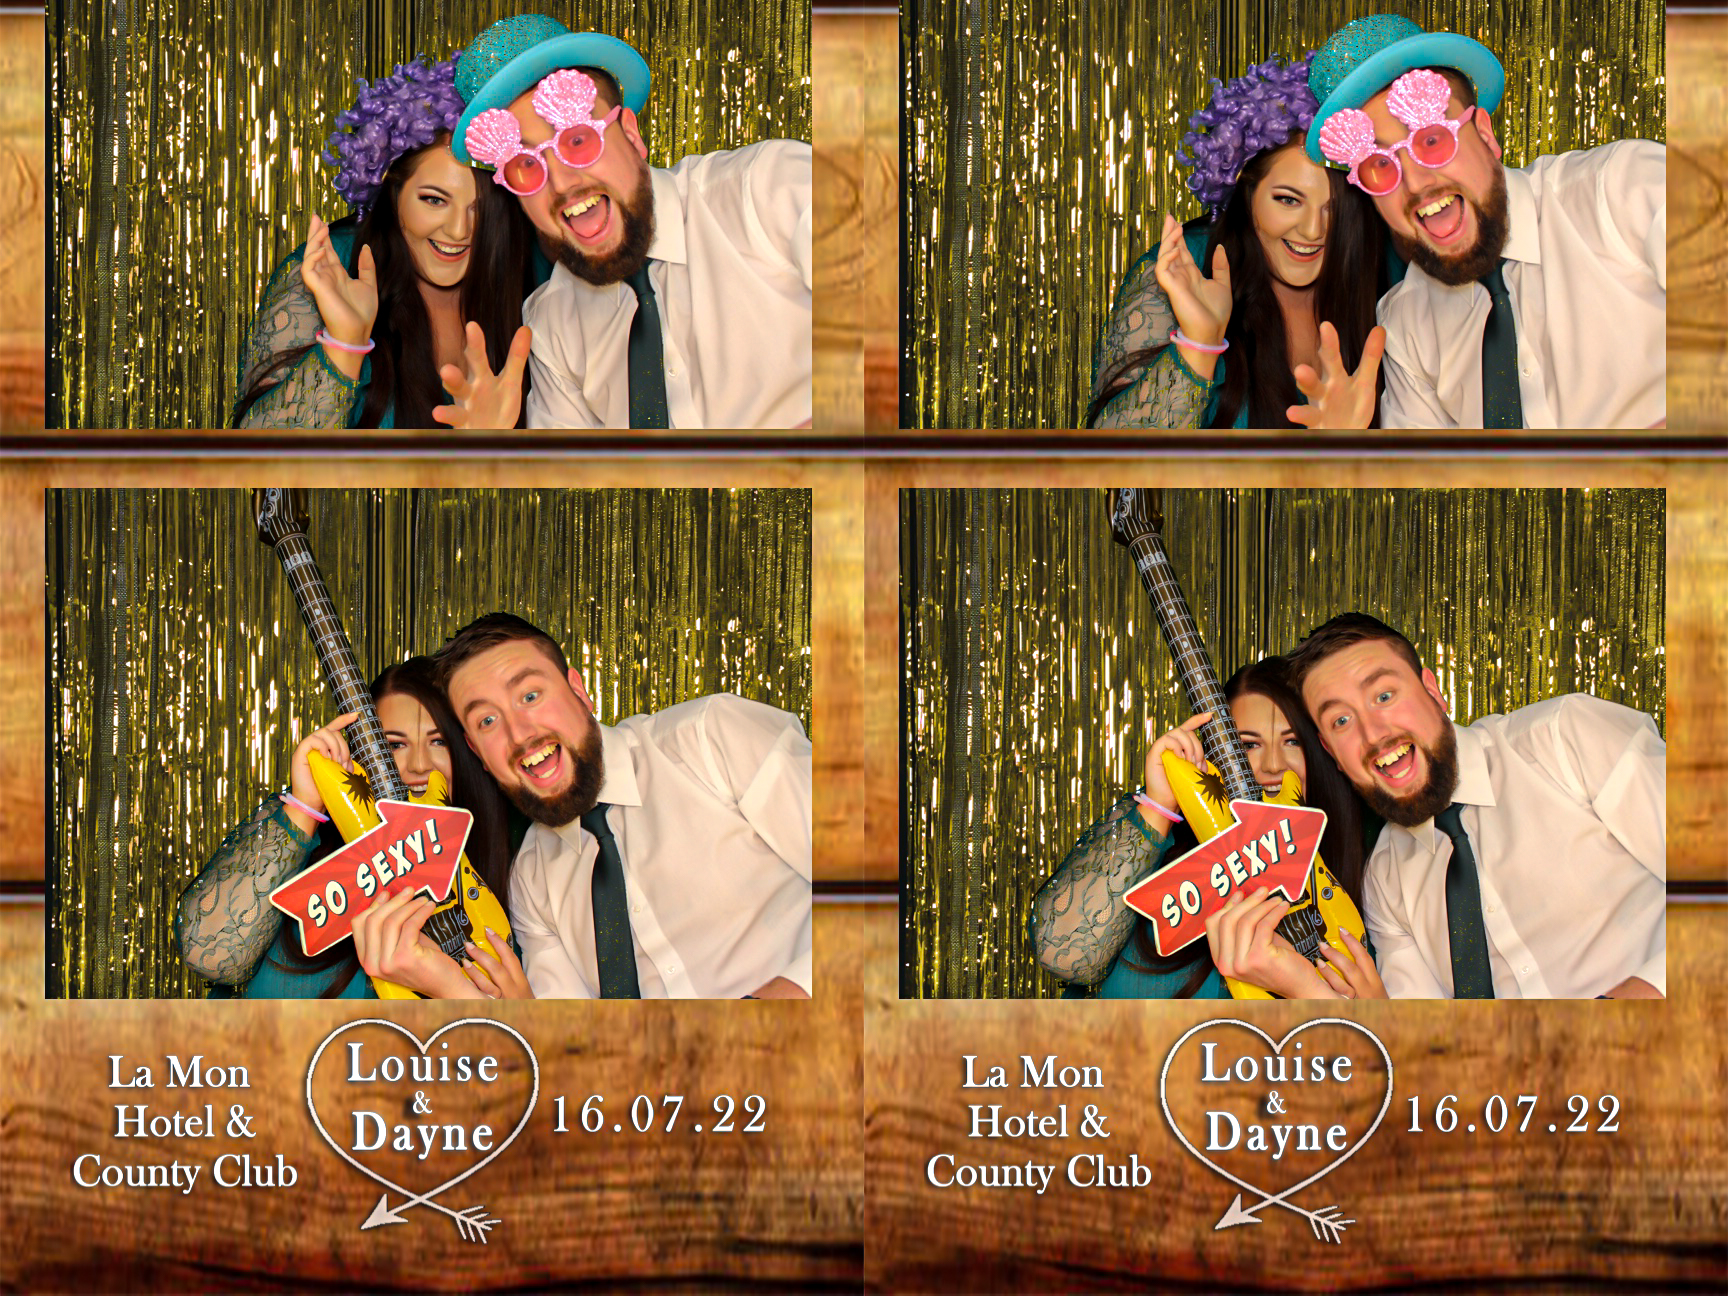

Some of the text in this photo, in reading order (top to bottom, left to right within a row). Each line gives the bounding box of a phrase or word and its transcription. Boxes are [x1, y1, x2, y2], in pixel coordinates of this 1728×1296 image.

[307, 818, 443, 928] SO SEXY!
[1161, 818, 1297, 928] SO SEXY!
